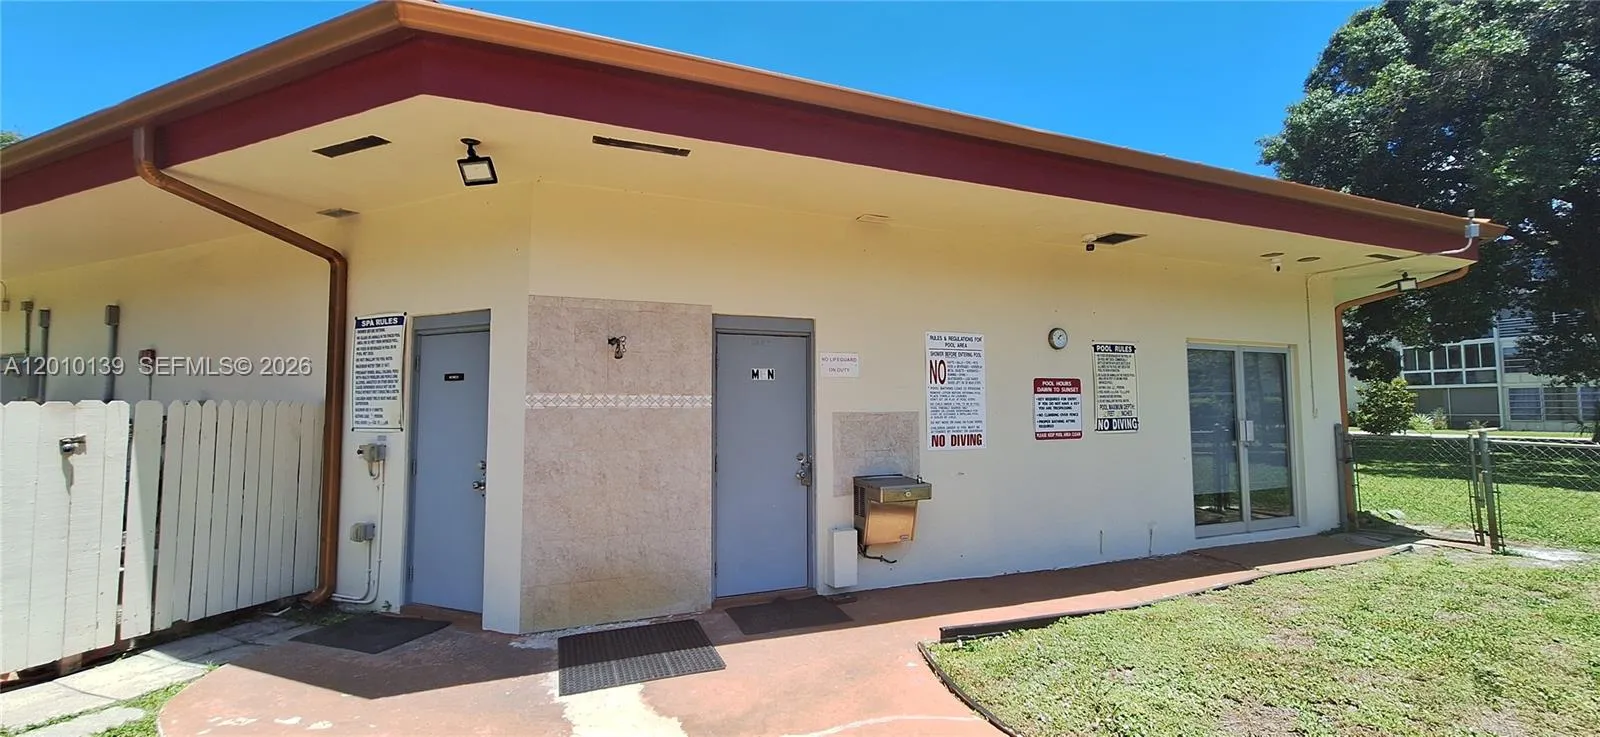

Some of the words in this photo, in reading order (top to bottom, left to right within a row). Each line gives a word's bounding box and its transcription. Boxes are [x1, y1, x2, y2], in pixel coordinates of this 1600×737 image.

[376, 317, 398, 326] RULES
[751, 368, 775, 380] MN
[930, 360, 946, 384] NO
[1098, 418, 1110, 430] NO
[1112, 418, 1138, 430] DIVING
[931, 434, 946, 447] NO
[950, 433, 983, 447] DIVING
